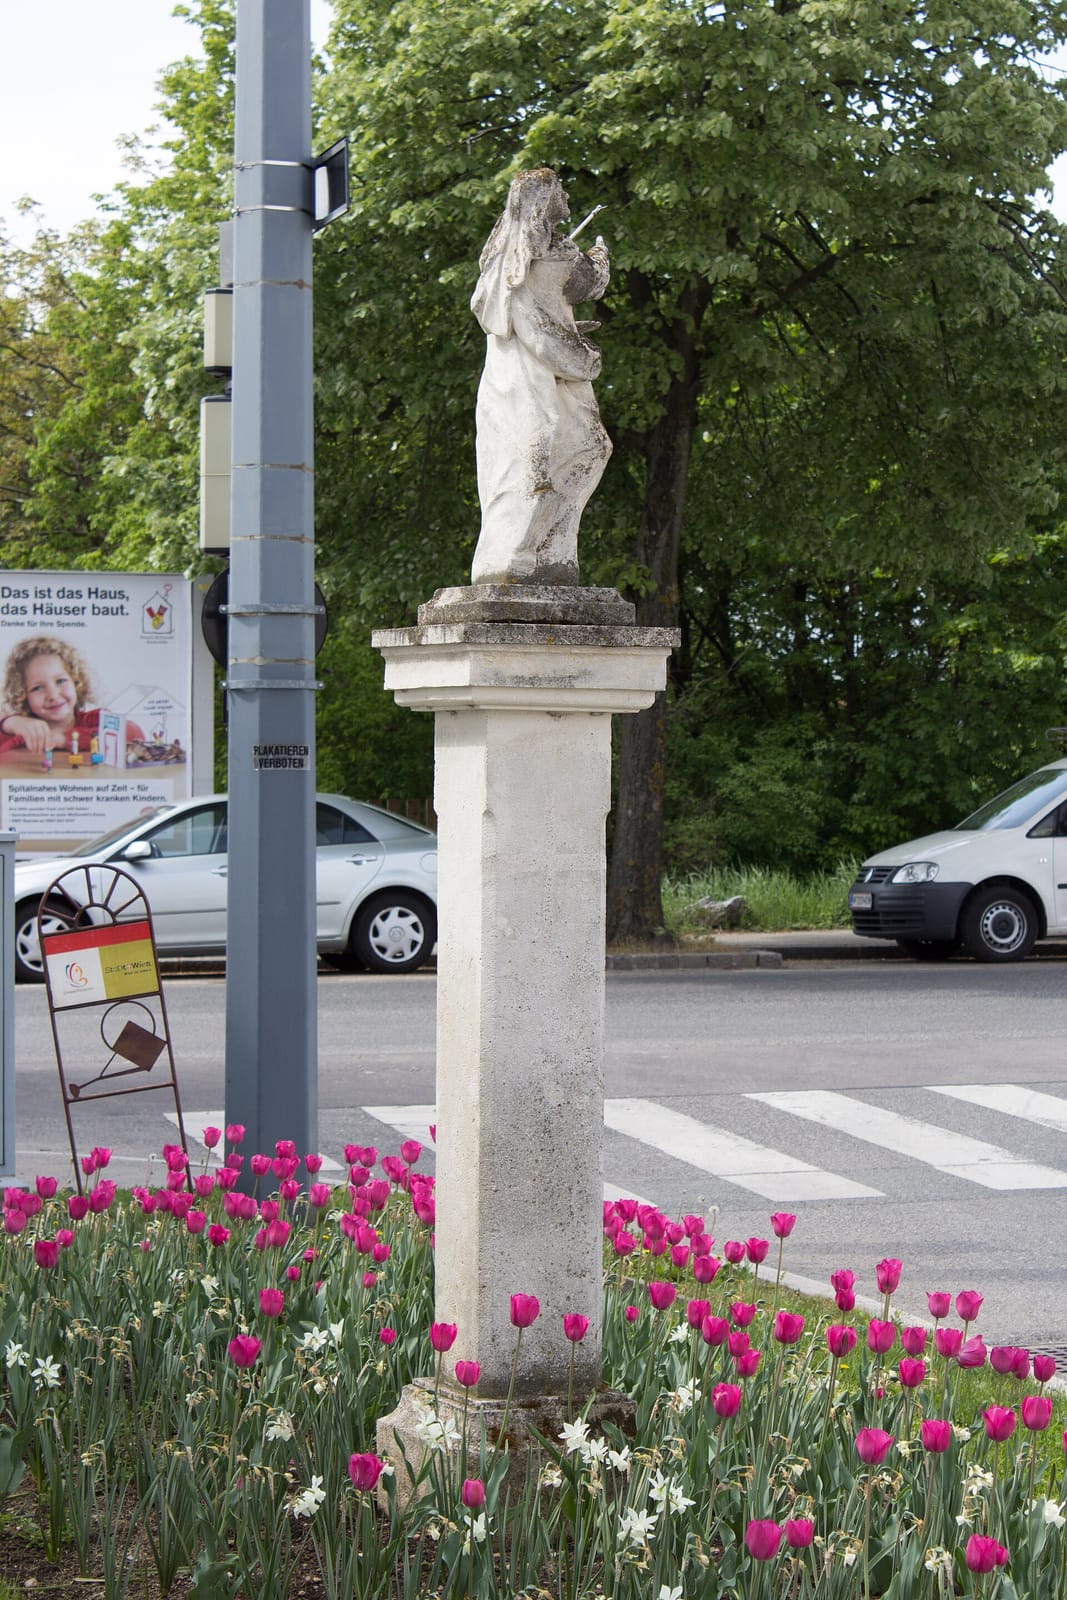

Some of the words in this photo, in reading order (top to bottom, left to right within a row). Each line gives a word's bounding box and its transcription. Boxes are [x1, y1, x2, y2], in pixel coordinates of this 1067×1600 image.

[0, 586, 29, 599] Das
[34, 586, 52, 599] ist
[56, 586, 83, 600] das
[87, 587, 130, 601] Haus,
[0, 602, 28, 615] das
[33, 602, 86, 616] Häuser
[91, 603, 129, 616] baut.
[253, 745, 309, 756] PLAKATIEREN
[258, 757, 305, 769] VERBOTEN
[8, 784, 57, 793] Spitalnahes
[59, 784, 94, 793] Wohnen
[96, 784, 109, 792] auf
[111, 784, 127, 792] Zeit
[137, 784, 149, 792] für
[8, 794, 45, 803] Familien
[47, 794, 61, 802] mit
[96, 794, 130, 802] kranken
